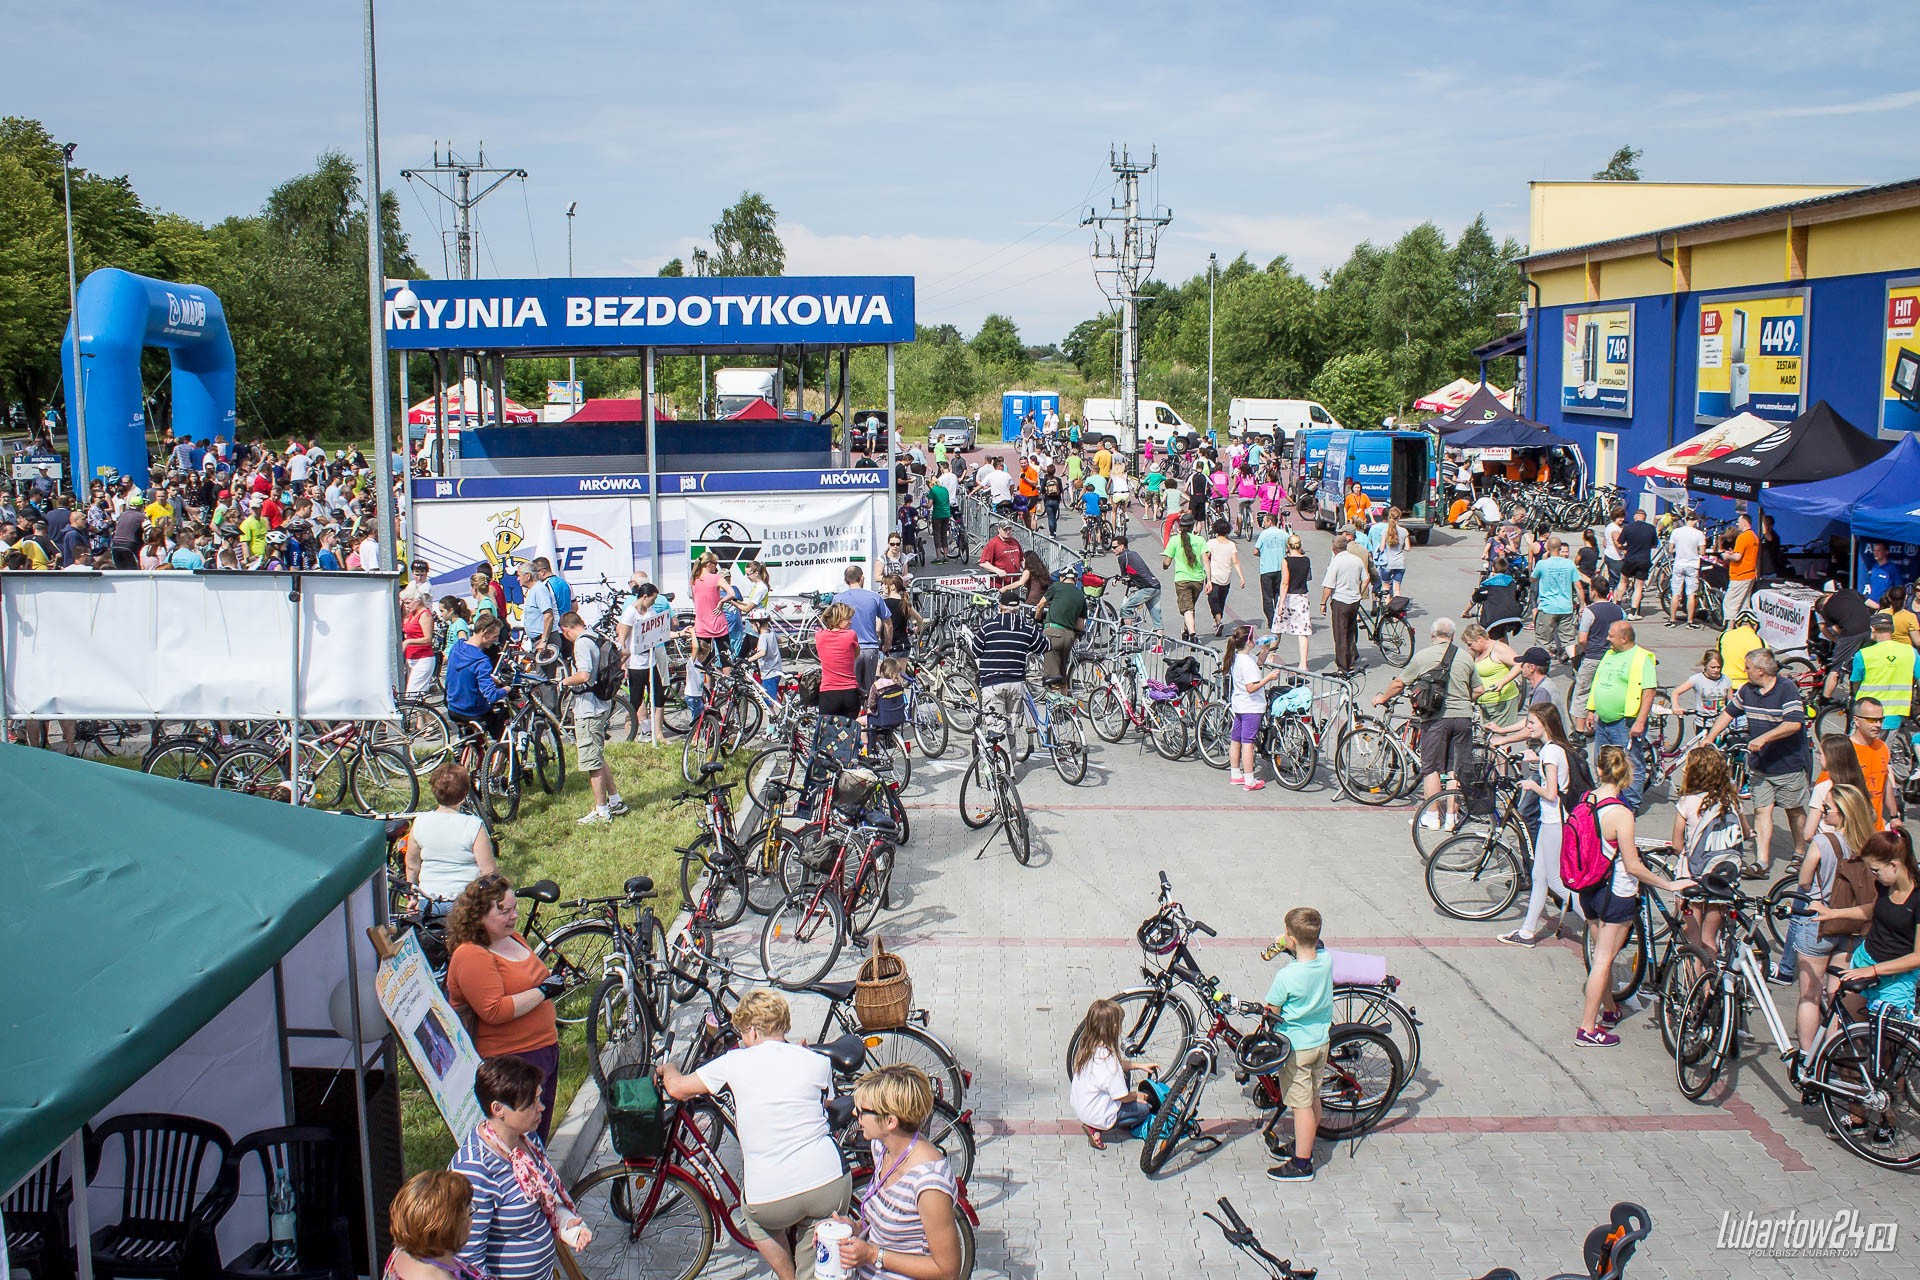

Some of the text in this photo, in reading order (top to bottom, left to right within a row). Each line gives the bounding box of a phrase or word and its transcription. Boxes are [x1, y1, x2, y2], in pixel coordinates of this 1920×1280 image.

[385, 295, 893, 330] MYJNIA BEZDOTYKOWA
[1895, 299, 1913, 317] HIT
[1705, 313, 1716, 327] HIT
[1777, 361, 1797, 370] ZESTAW
[1780, 376, 1797, 385] MARO
[579, 476, 642, 491] MRÓWKA
[820, 471, 880, 485] MRÓWKA
[1693, 475, 1710, 486] internet
[1734, 482, 1751, 493] telefon
[785, 557, 847, 567] SPÓŁKA AKCYJNA
[641, 617, 665, 634] ZAPISY
[688, 1156, 720, 1200] RETRO
